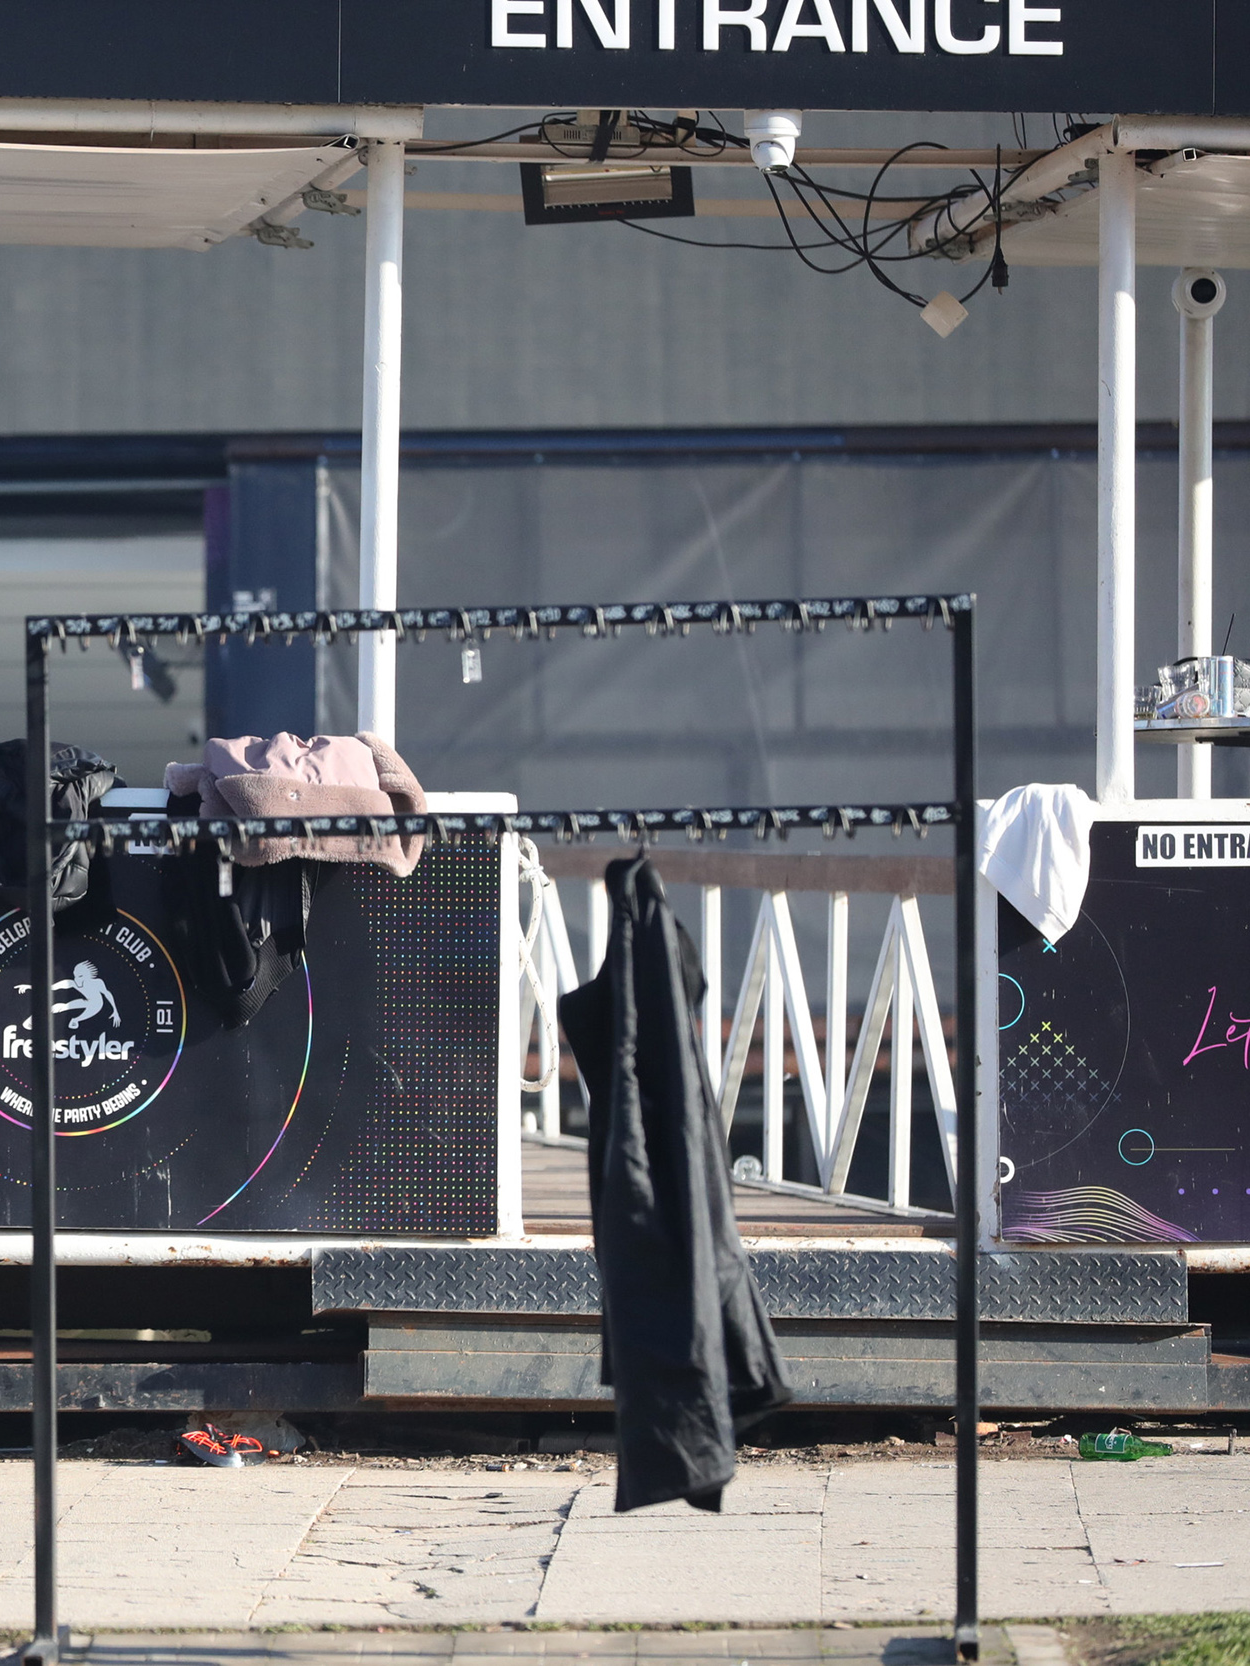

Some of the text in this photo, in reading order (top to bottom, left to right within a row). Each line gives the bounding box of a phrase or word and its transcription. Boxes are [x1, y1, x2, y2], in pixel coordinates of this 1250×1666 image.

[1142, 833, 1250, 860] NO ENTR
[115, 926, 152, 963] CLUB
[156, 1009, 174, 1026] 01
[64, 1103, 102, 1123] PARTY
[101, 1082, 142, 1116] BEGINS
